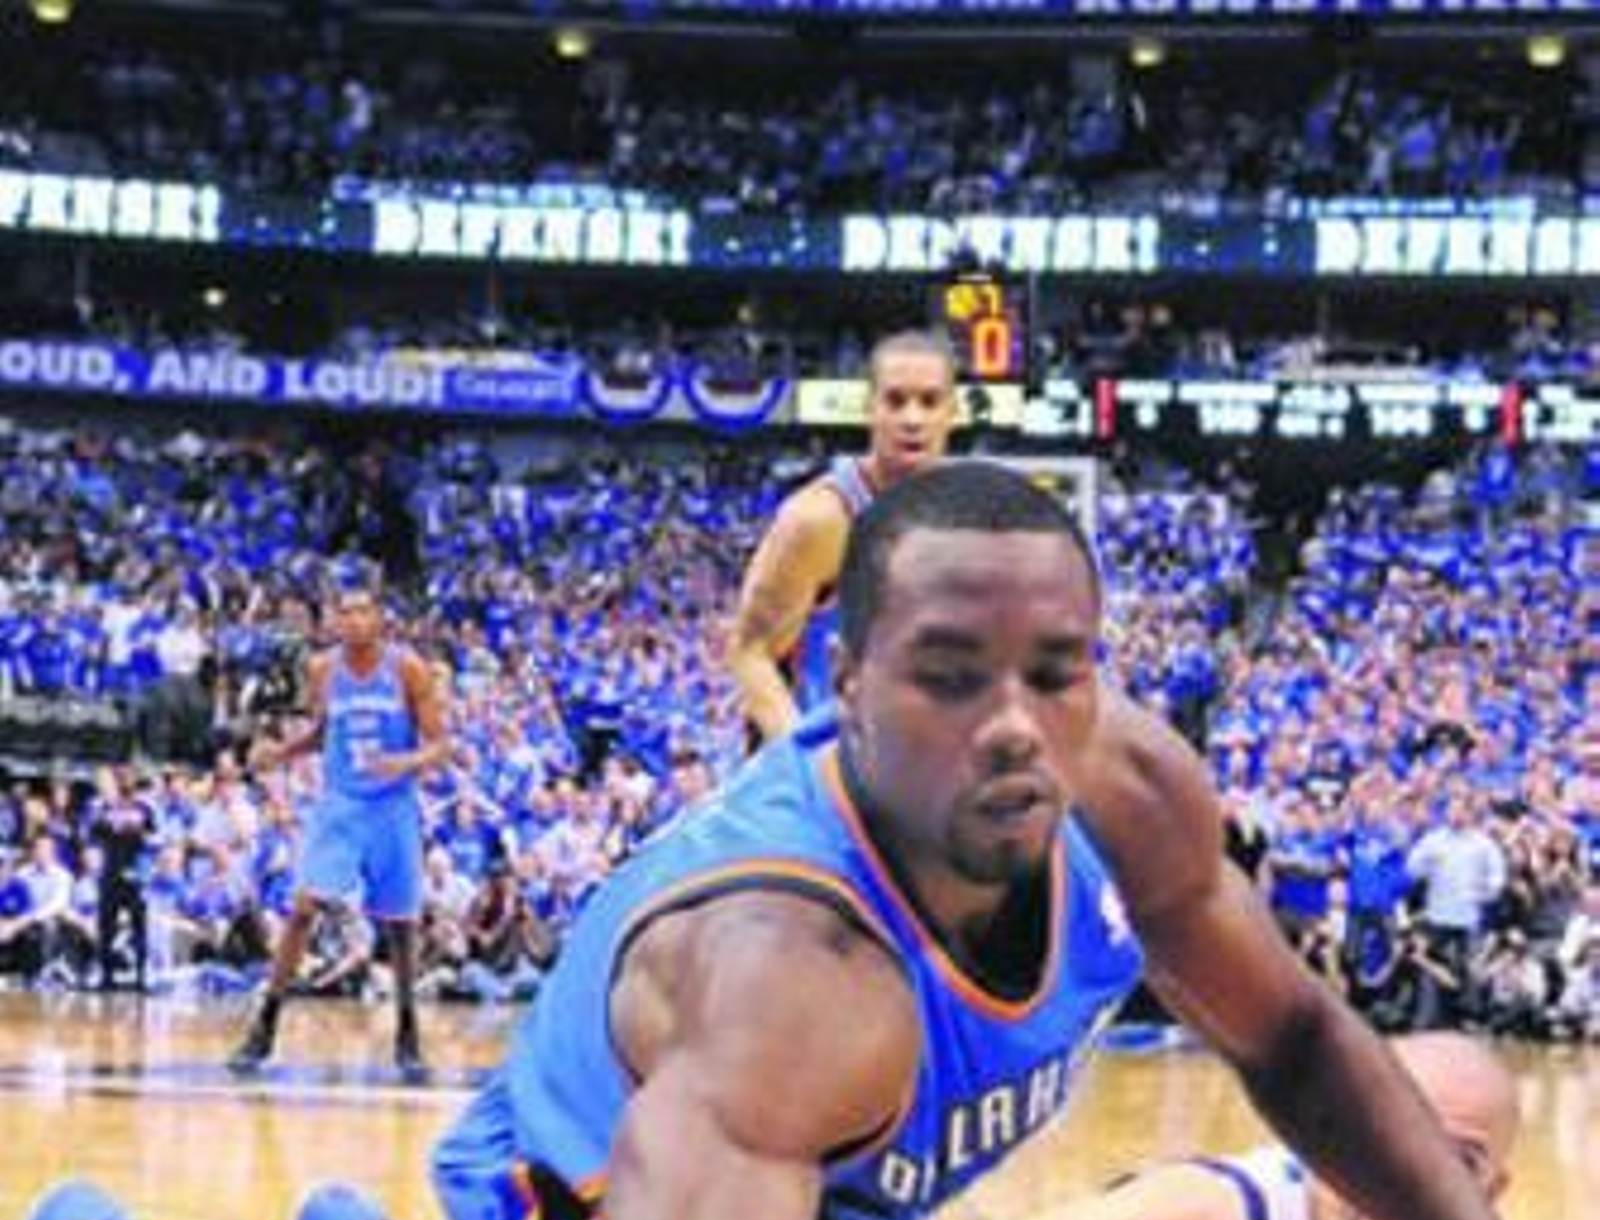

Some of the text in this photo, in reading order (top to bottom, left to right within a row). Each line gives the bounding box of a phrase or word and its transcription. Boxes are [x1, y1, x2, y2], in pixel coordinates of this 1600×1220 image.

[372, 197, 692, 266] DEFENSE!
[148, 348, 268, 396] AND
[284, 360, 443, 407] LOUD!
